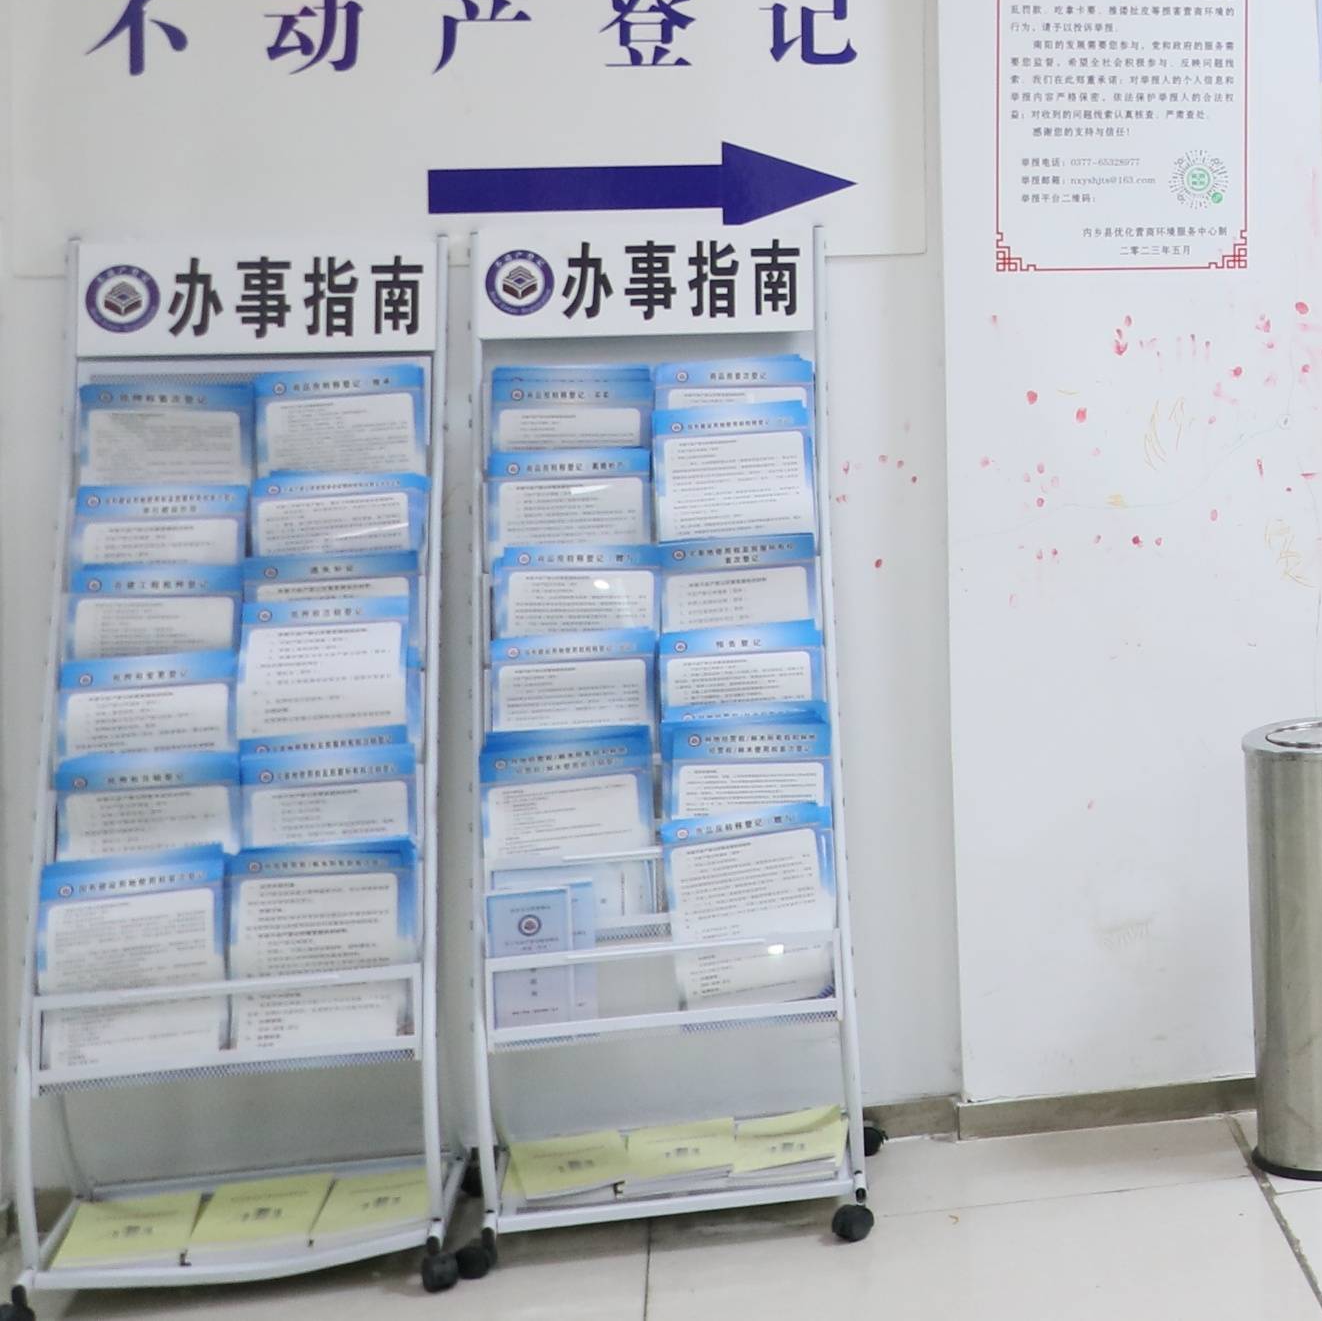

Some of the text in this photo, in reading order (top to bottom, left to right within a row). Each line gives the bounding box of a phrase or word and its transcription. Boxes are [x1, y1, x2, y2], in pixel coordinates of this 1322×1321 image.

[562, 239, 801, 320] 办事指南
[1119, 245, 1192, 256] 二零二三年五月
[167, 254, 425, 339] 办事指南
